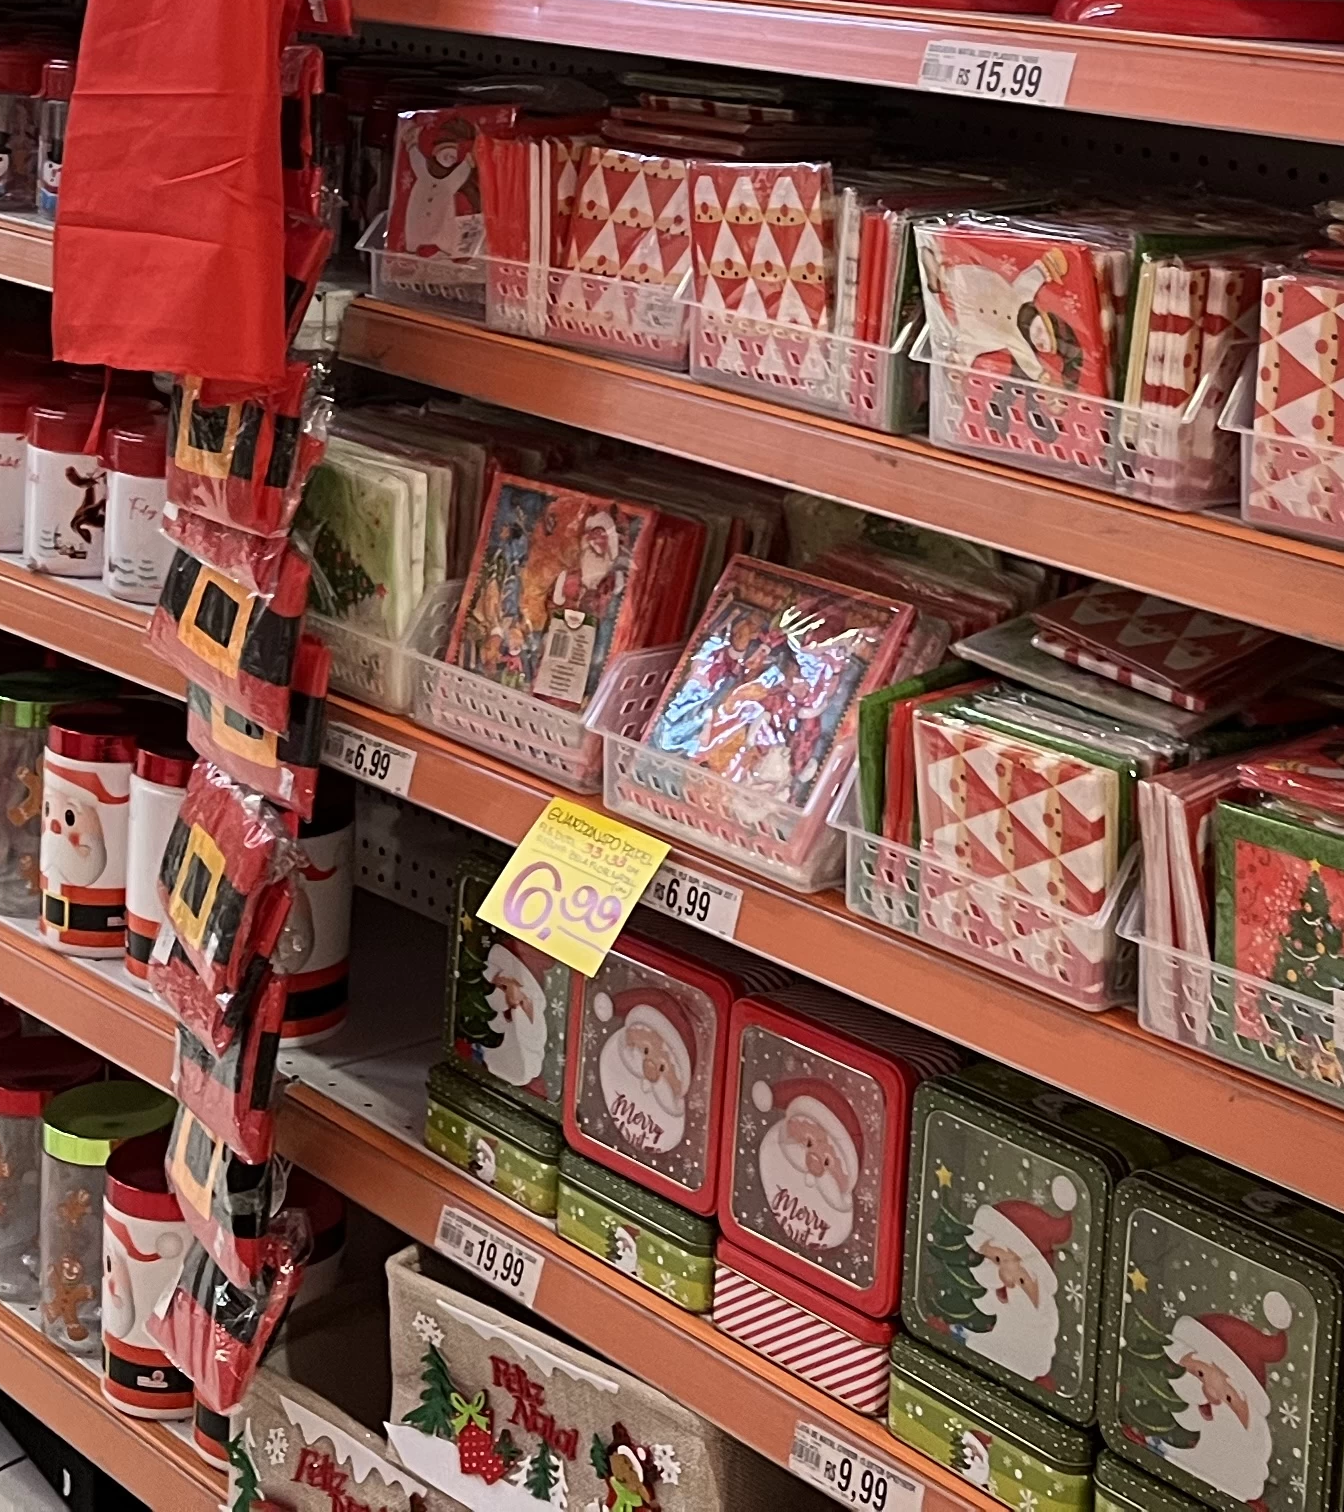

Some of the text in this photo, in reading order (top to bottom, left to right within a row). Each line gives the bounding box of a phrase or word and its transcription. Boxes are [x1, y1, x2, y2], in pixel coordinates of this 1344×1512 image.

[976, 60, 1042, 97] 15,99
[355, 743, 390, 780] 6,99
[503, 860, 623, 941] 6,99
[666, 878, 711, 922] 6,99
[612, 1091, 664, 1144] Merry
[774, 1185, 830, 1240] Merry
[477, 1239, 524, 1287] 19,99
[489, 1355, 545, 1407] Feliz
[506, 1394, 579, 1462] Natal
[290, 1447, 349, 1494] Feliz
[837, 1458, 888, 1512] 9,99
